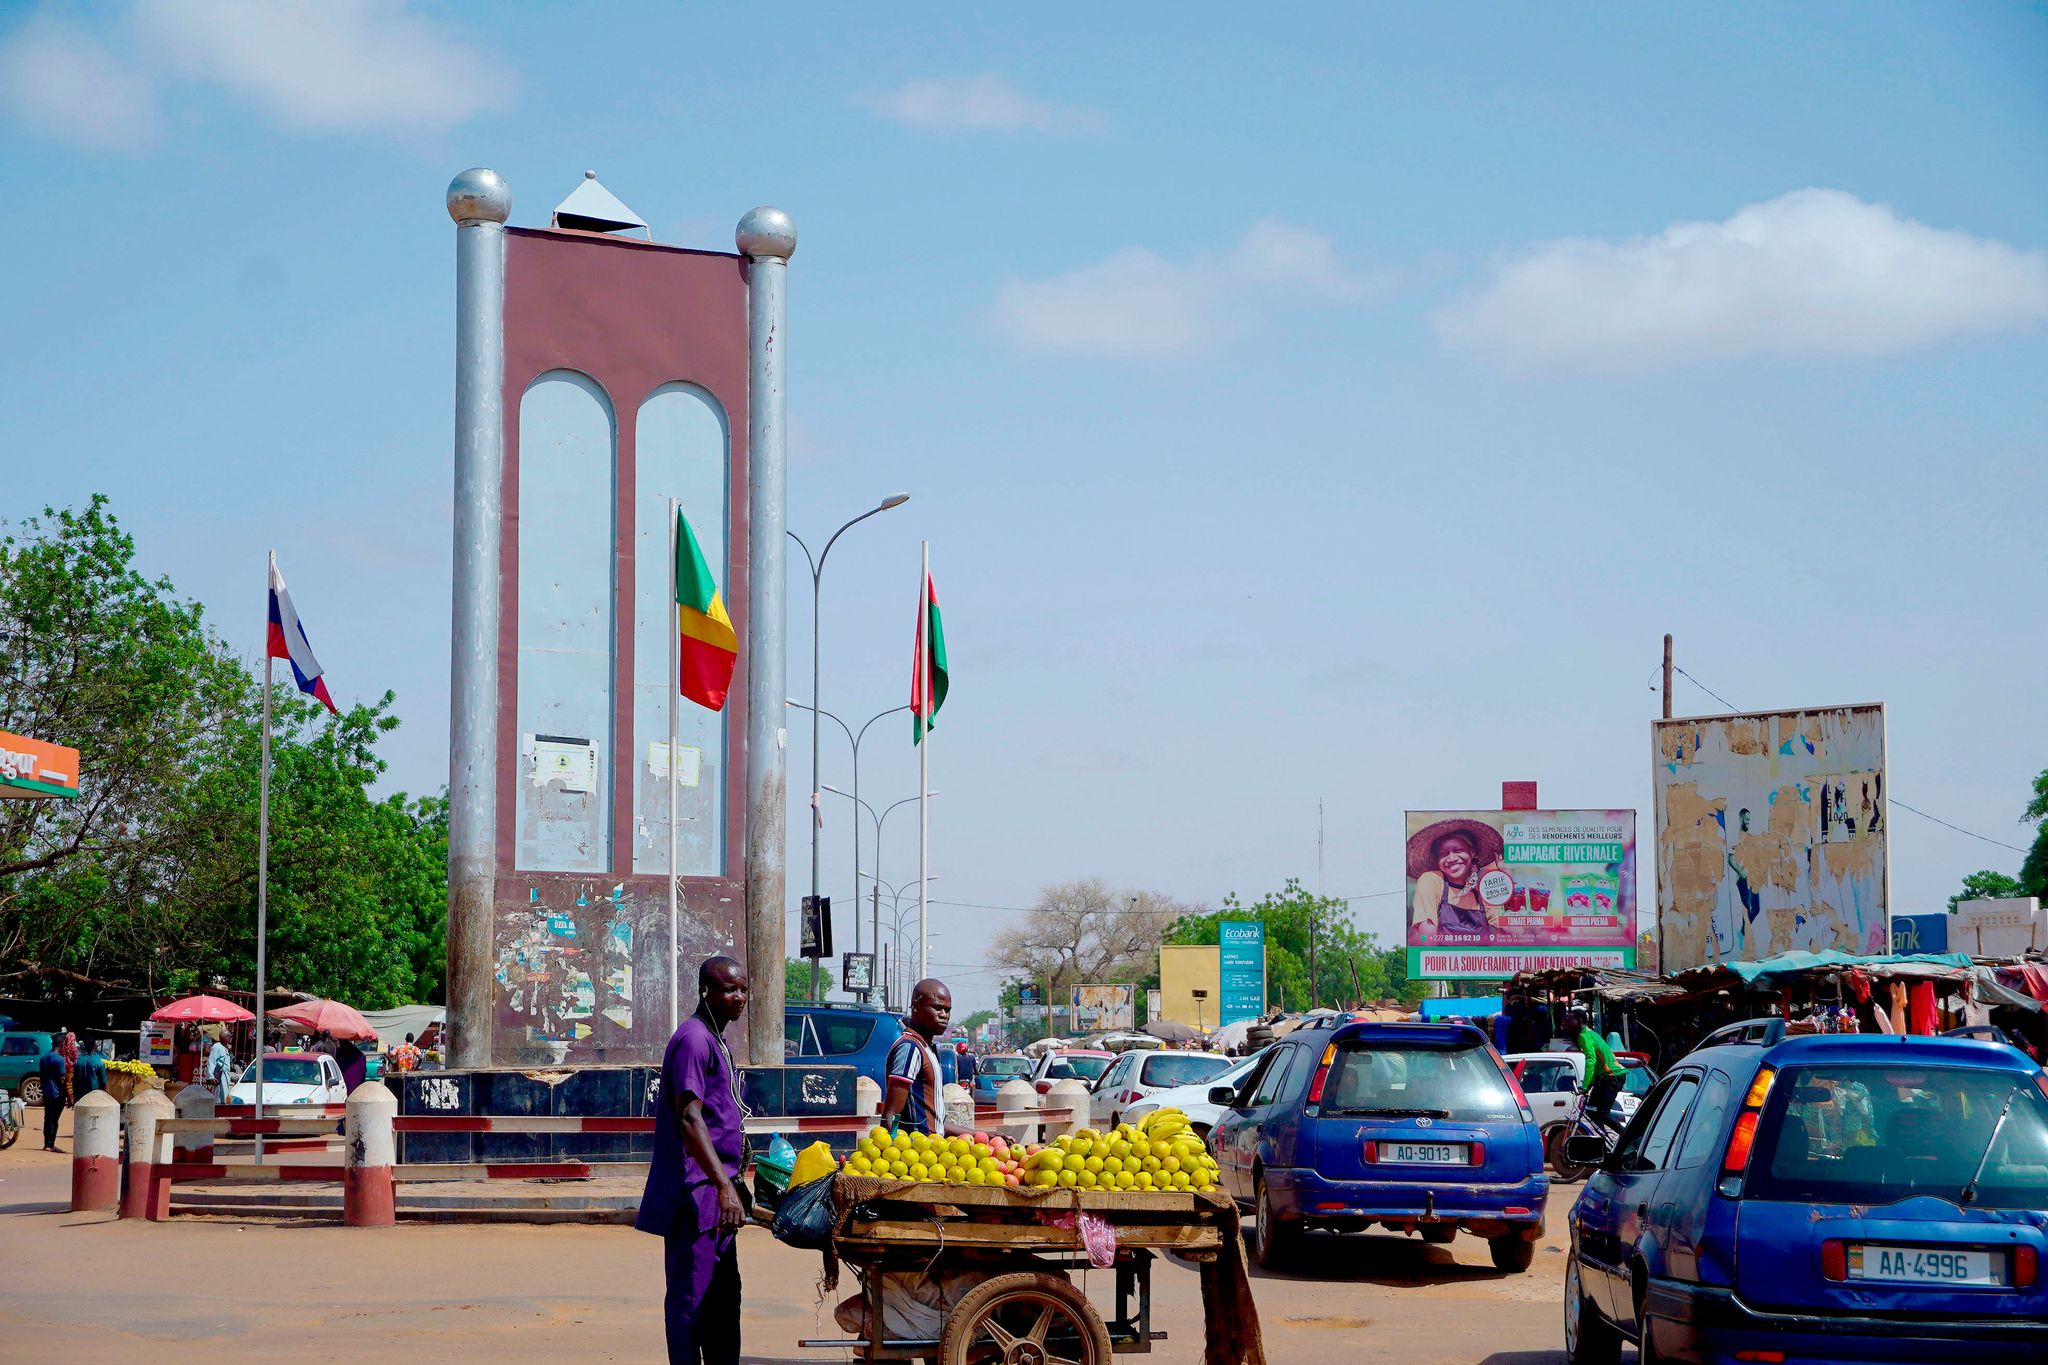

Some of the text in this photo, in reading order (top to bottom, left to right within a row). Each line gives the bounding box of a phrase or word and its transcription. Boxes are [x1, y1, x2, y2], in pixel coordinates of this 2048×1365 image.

[1542, 832, 1585, 840] RENDEMENTS
[1587, 832, 1623, 840] MEILLEURS
[1508, 844, 1618, 861] CAMPAGNE HIVERNALE
[1483, 875, 1505, 887] TARIF
[1225, 926, 1260, 938] Ecobank
[1424, 956, 1447, 971] POUR
[1449, 956, 1459, 971] LA
[1397, 1146, 1450, 1161] AQ-9013
[1879, 1251, 1968, 1279] AA-4996
